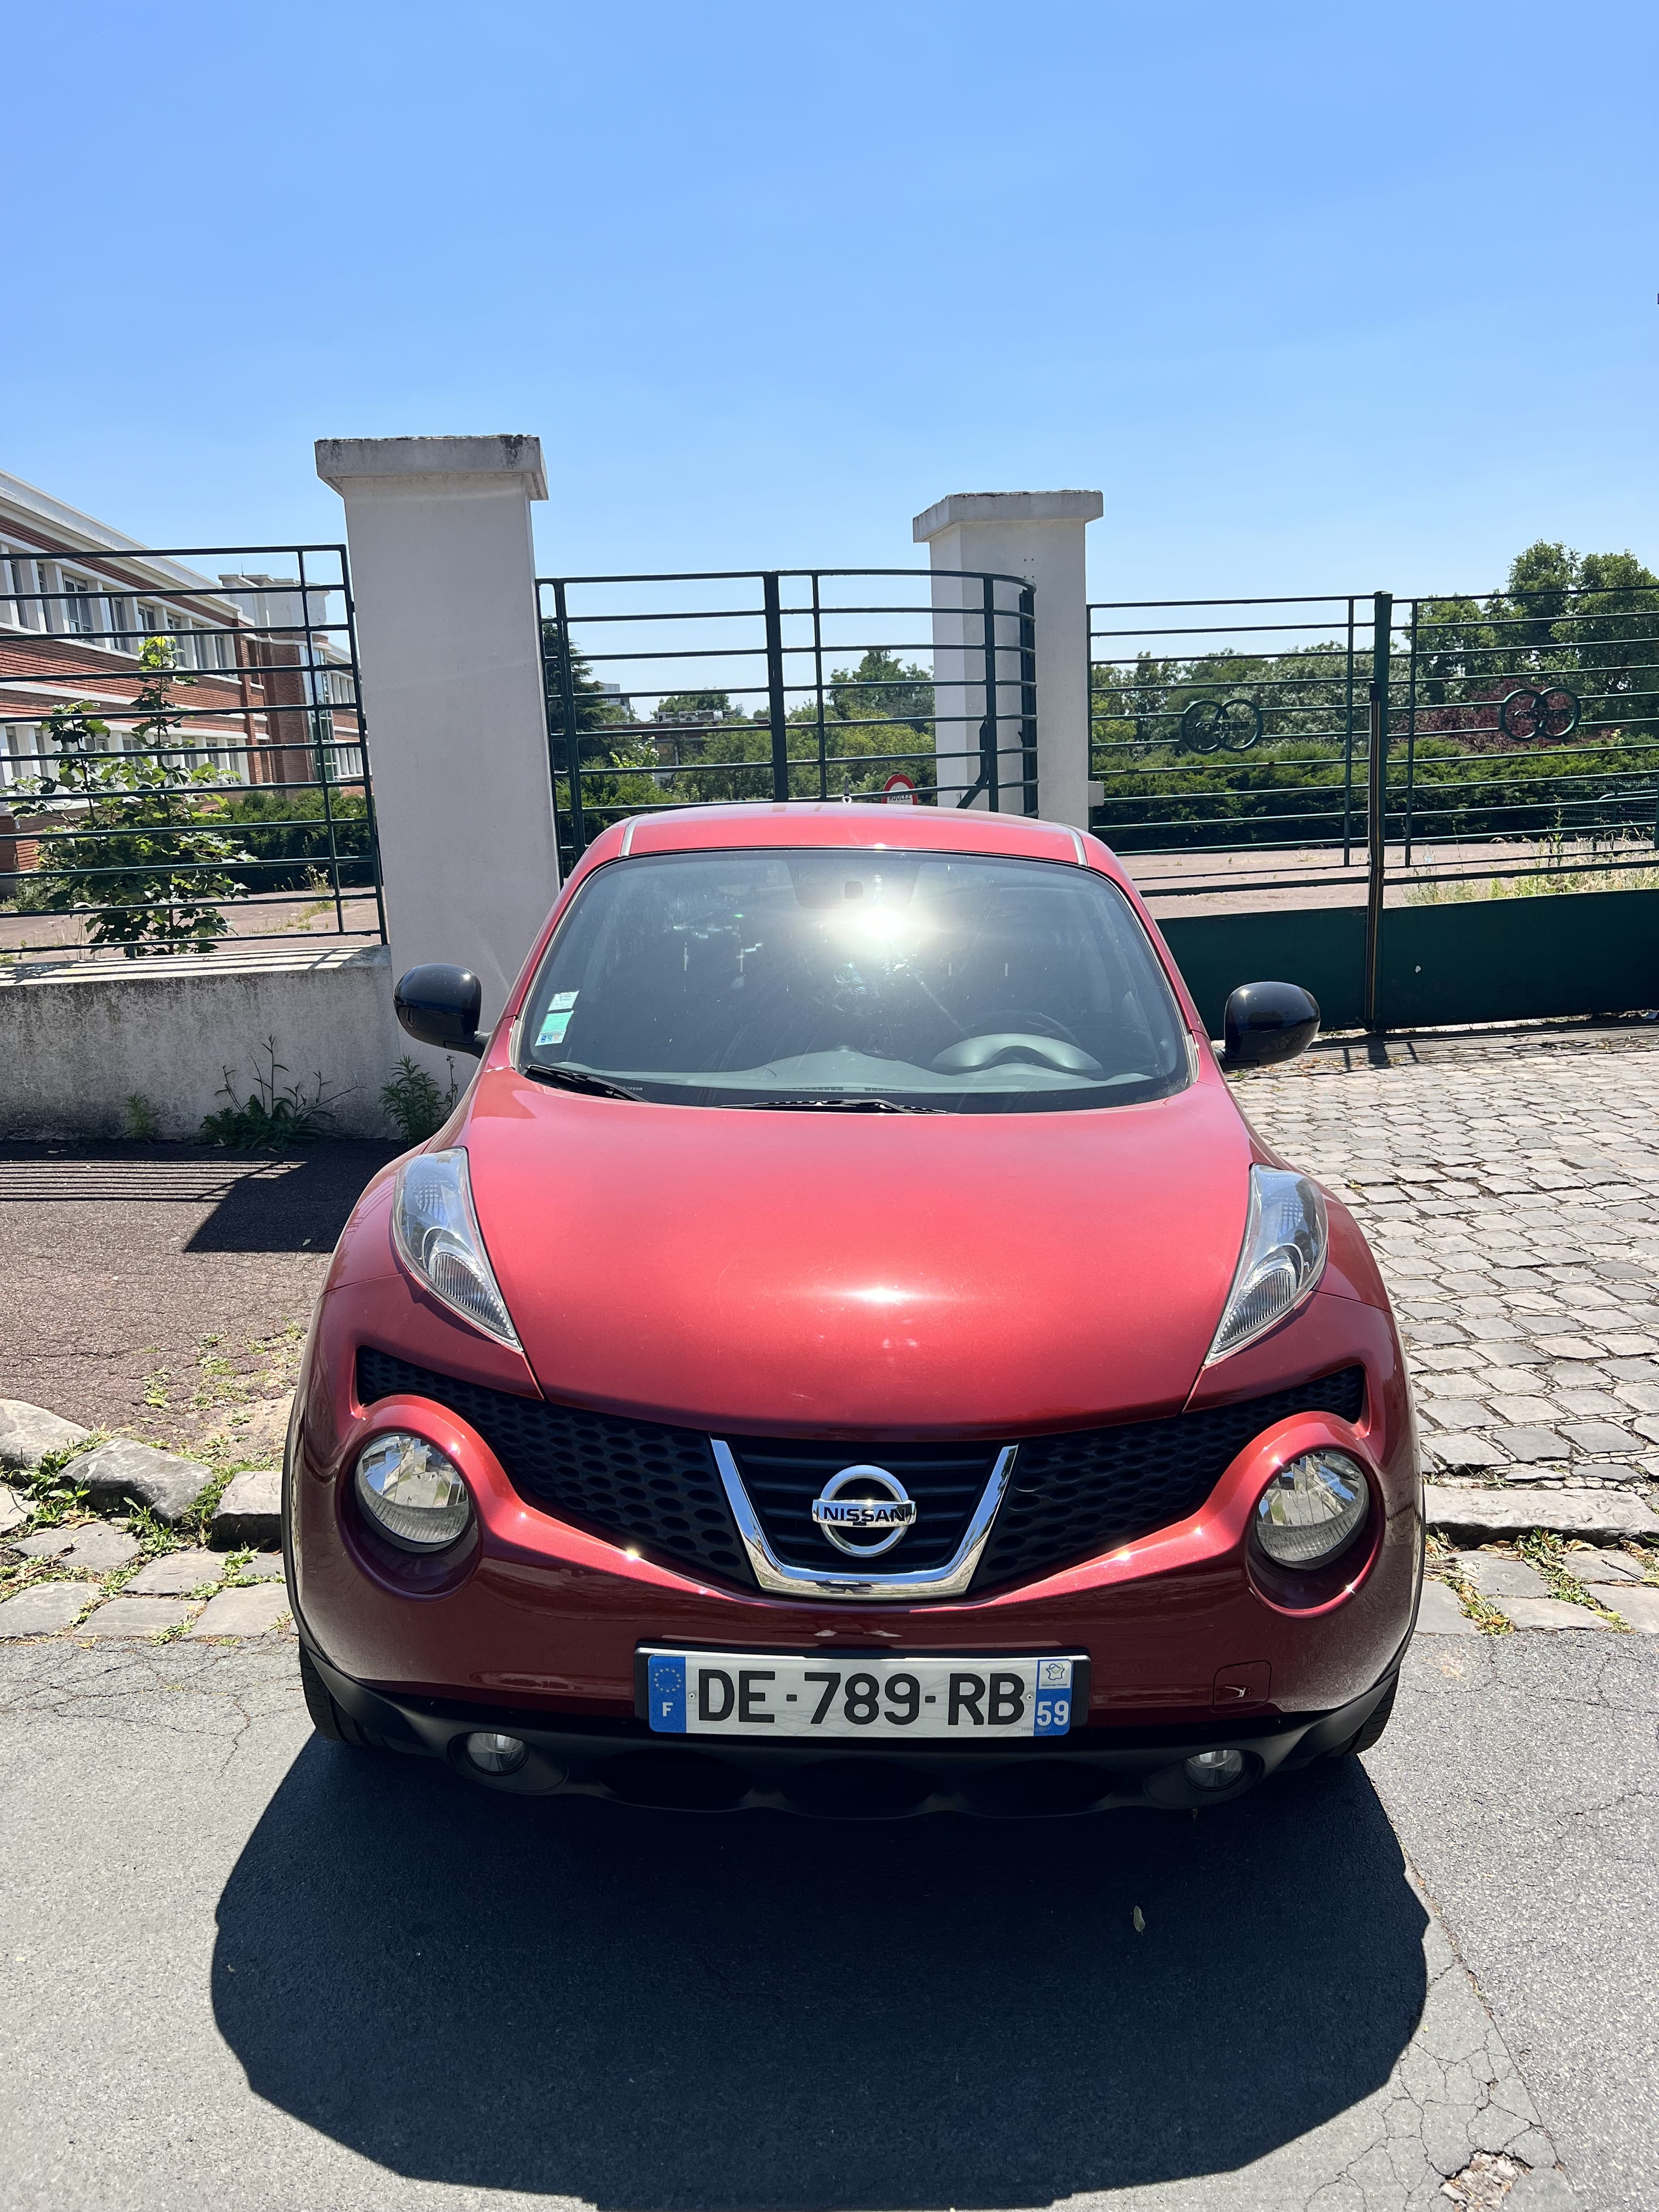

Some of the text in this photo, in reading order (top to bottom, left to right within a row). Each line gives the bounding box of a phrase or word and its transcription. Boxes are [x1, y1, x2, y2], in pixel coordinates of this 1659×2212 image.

[823, 1506, 905, 1522] NISSAN
[698, 1669, 1025, 1726] DE-789-RB
[662, 1702, 673, 1717] F
[1037, 1700, 1069, 1726] 59
